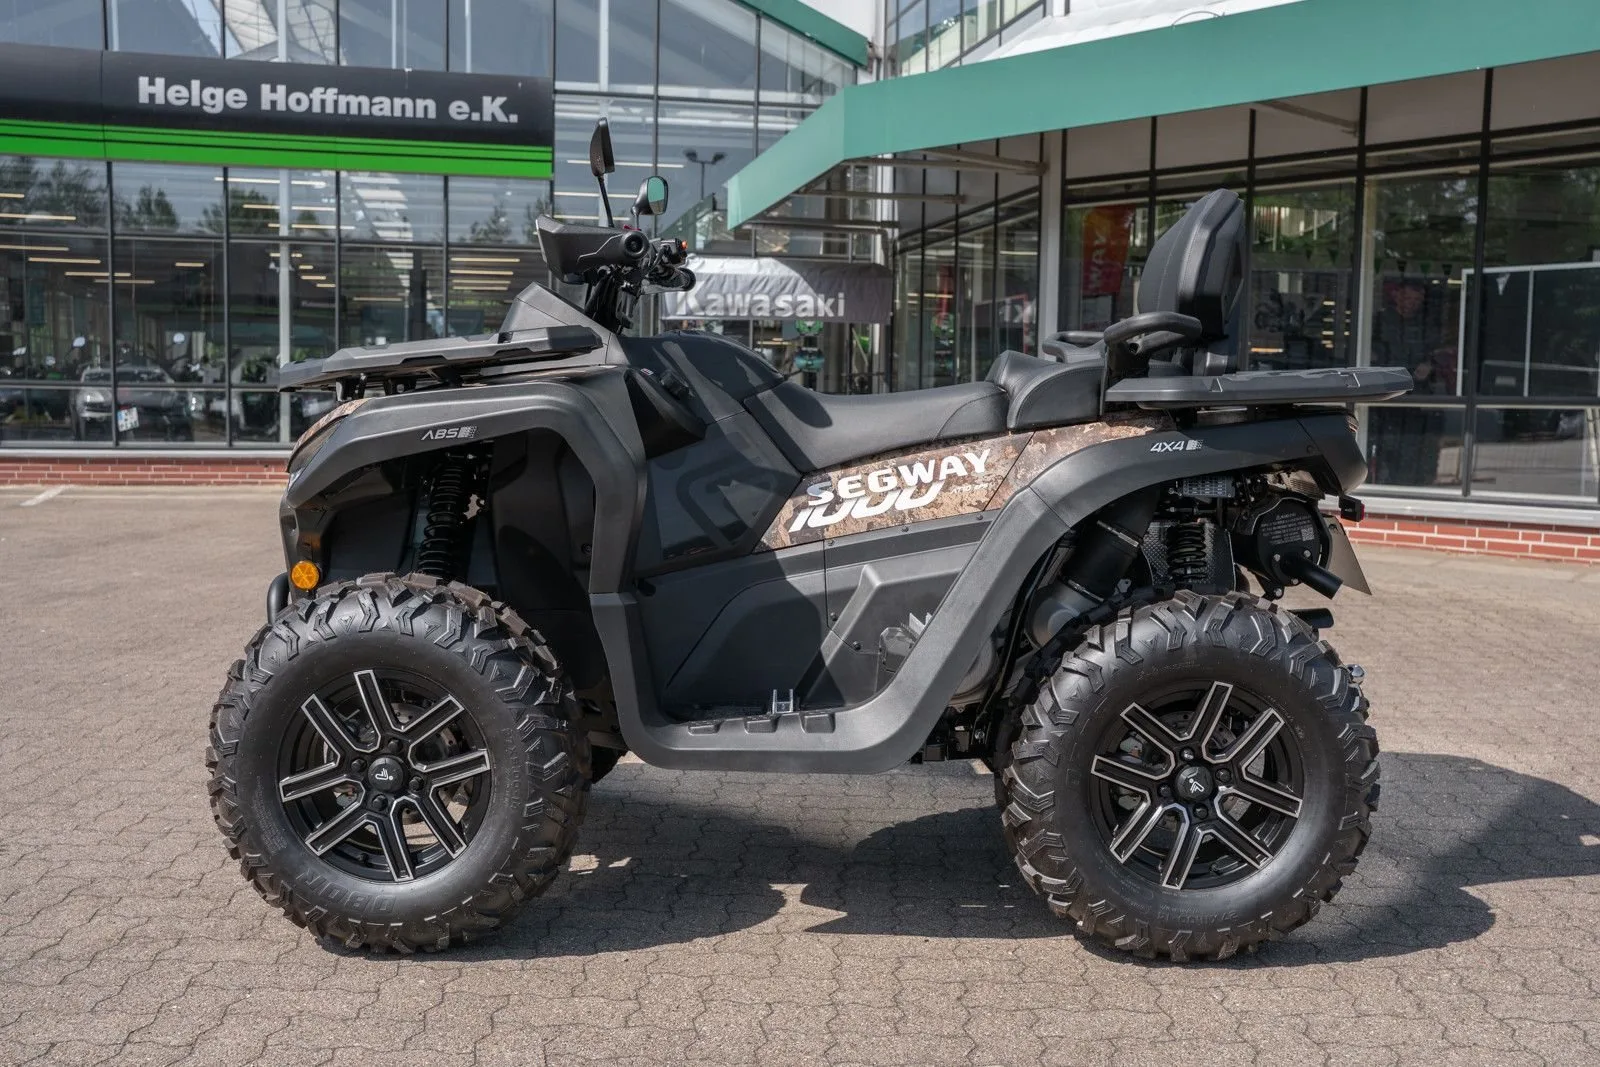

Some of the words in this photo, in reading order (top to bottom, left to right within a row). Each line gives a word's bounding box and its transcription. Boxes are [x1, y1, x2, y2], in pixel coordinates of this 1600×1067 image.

[138, 76, 248, 114] Helge
[260, 83, 437, 119] Hoffmann
[448, 96, 519, 123] e.K.
[675, 280, 845, 318] Kawasaki
[420, 427, 460, 441] ABS
[1150, 440, 1185, 453] 4X4
[806, 448, 990, 506] SEGWAY
